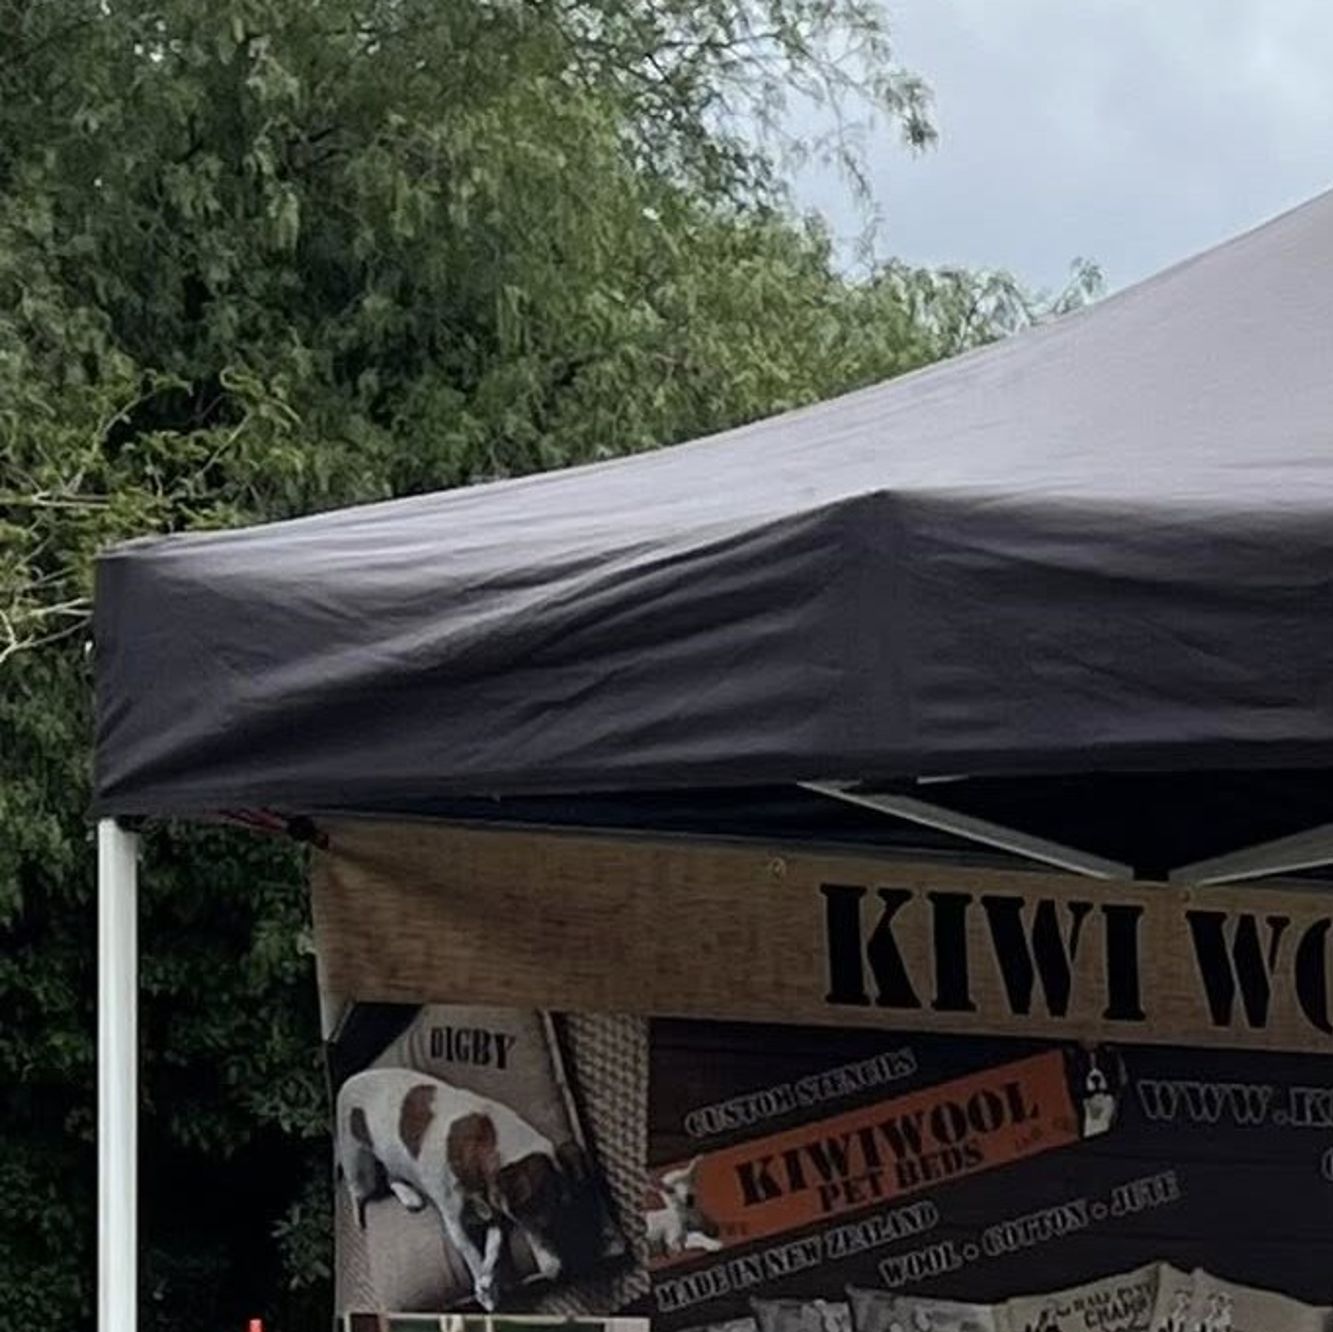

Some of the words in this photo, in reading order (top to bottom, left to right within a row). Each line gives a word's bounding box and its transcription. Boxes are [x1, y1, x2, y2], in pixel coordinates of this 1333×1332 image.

[820, 882, 1147, 1022] KIWI
[430, 1026, 516, 1070] DIGBY
[683, 1082, 799, 1137] CUSTOM
[736, 1082, 1039, 1206] KIWIWOOL
[818, 1172, 886, 1211] PET
[899, 1143, 984, 1187] BEDS
[878, 1240, 965, 1287] WOOL
[981, 1199, 1090, 1256] COTTON
[1110, 1170, 1182, 1217] JUTE
[656, 1268, 730, 1312] MADE
[731, 1258, 764, 1288] IN
[762, 1238, 822, 1279] NEW
[826, 1201, 940, 1258] ZEALAND
